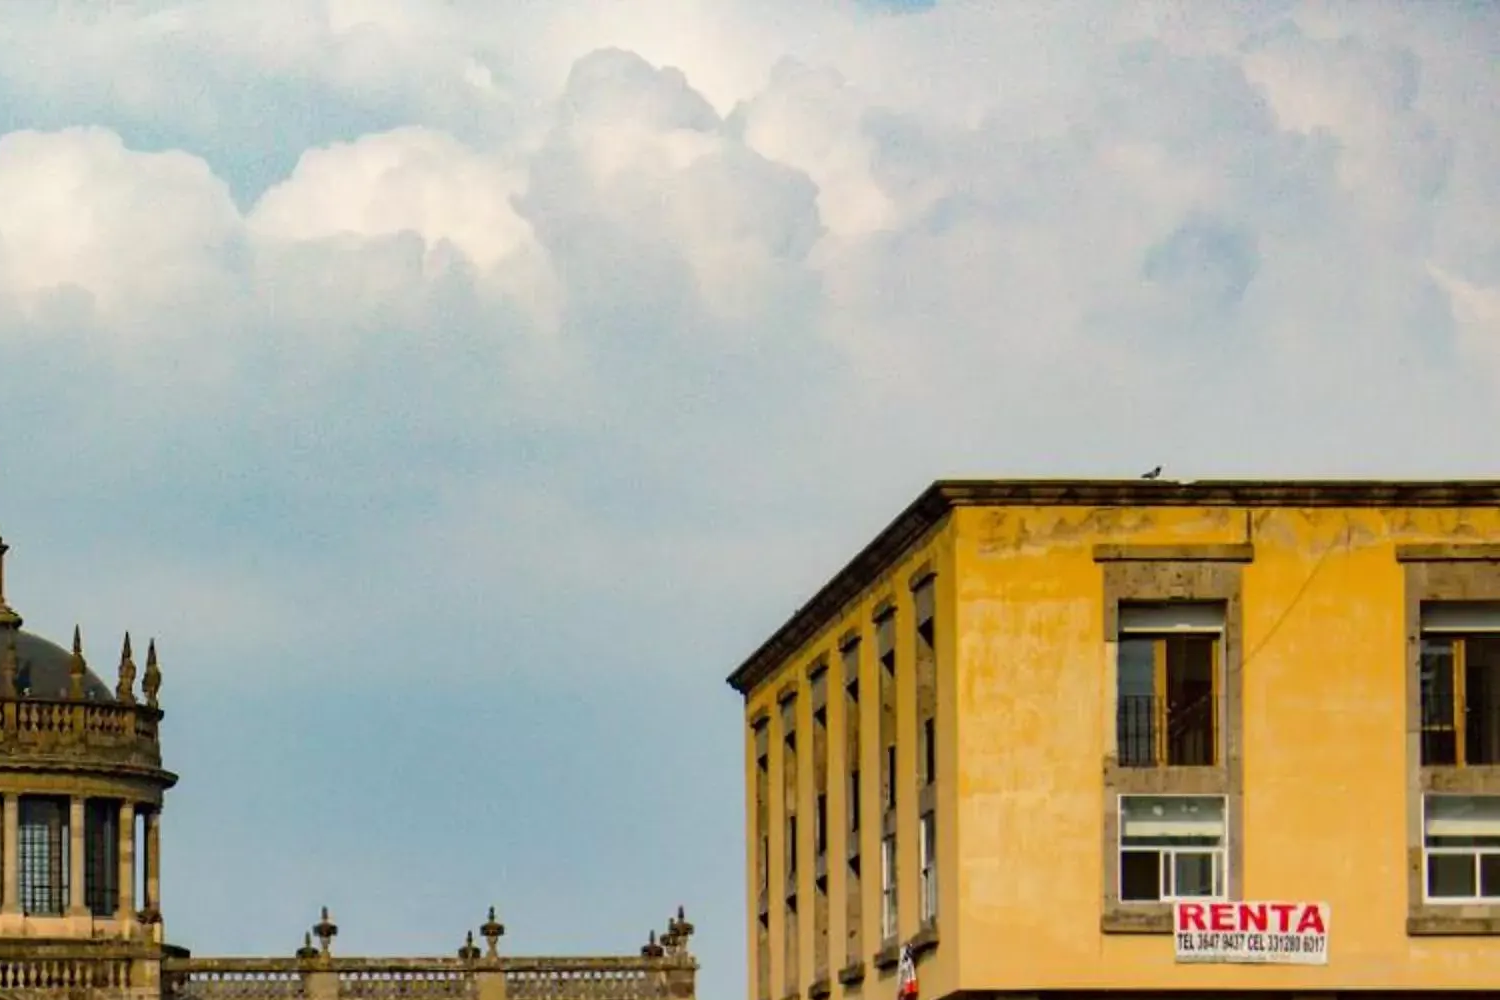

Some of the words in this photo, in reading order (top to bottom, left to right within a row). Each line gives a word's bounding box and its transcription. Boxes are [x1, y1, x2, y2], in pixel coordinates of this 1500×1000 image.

[1179, 903, 1325, 934] RENTA
[1178, 933, 1195, 950] TEL
[1248, 934, 1266, 951] CEL
